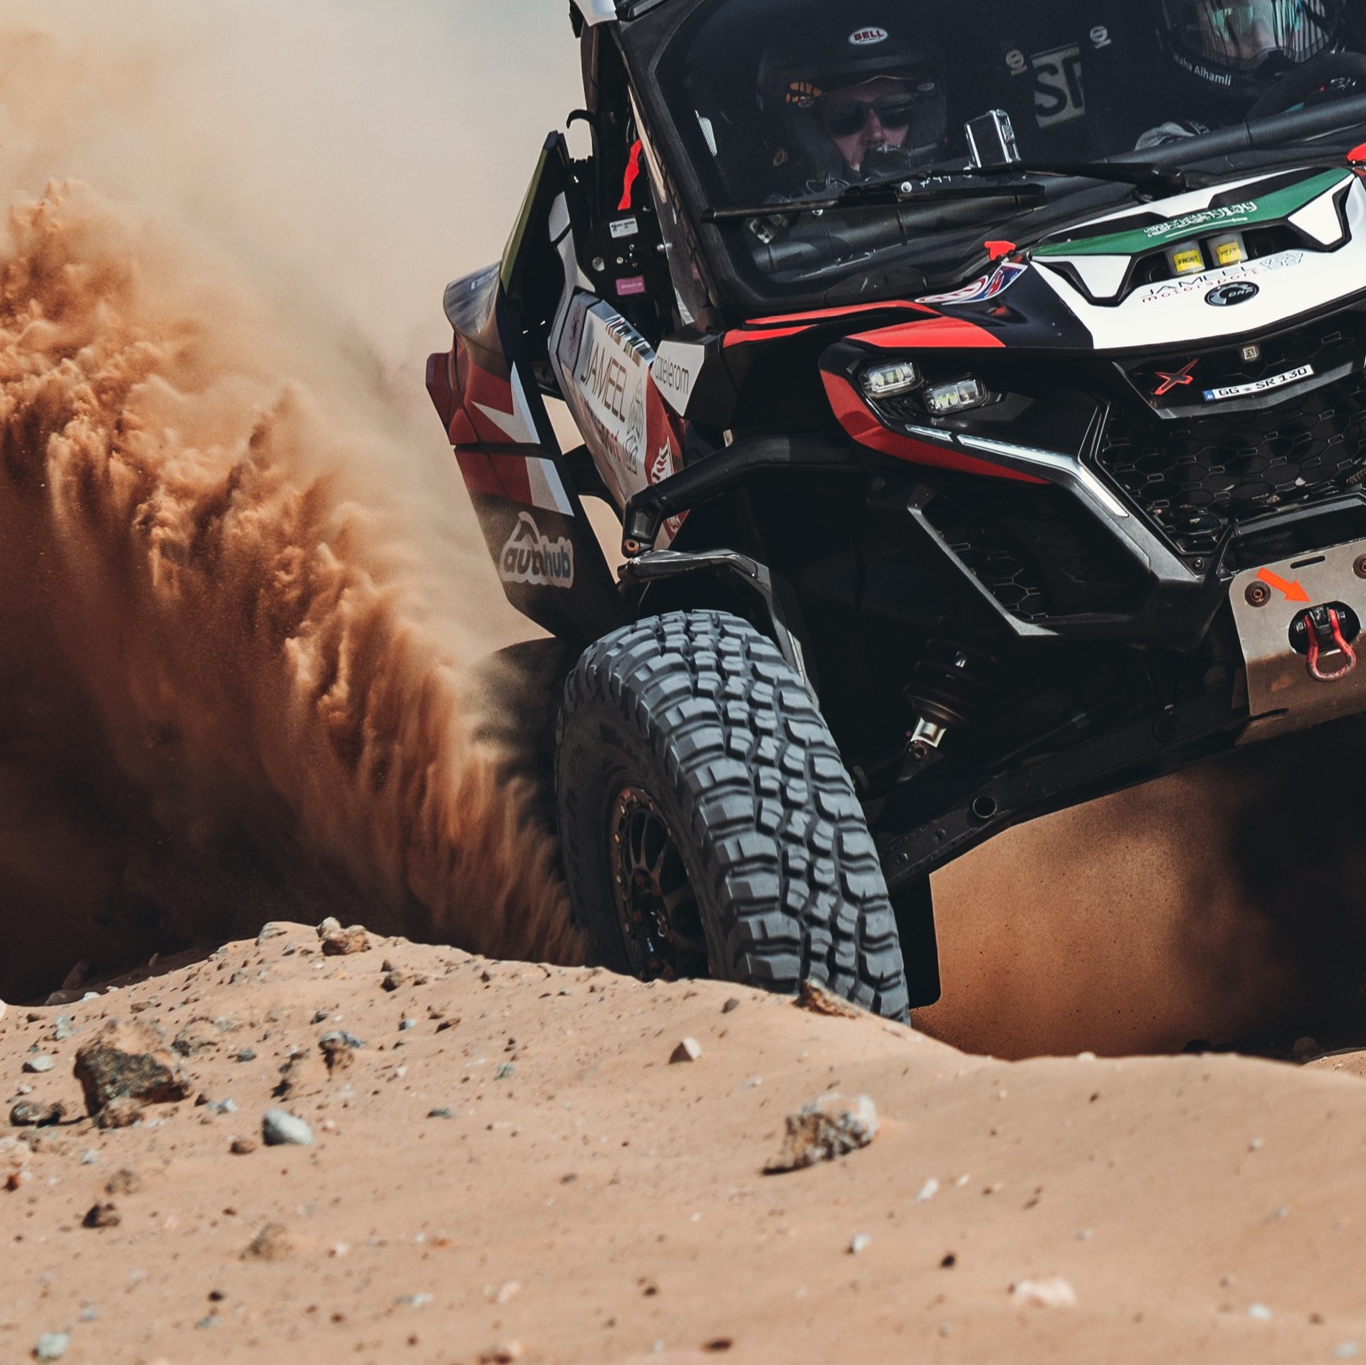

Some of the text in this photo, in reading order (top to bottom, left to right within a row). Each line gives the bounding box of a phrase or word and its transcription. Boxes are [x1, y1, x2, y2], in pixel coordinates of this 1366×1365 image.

[853, 29, 884, 41] BELL
[1194, 65, 1232, 86] Alhamli
[1178, 254, 1198, 266] FRONT
[1141, 265, 1256, 298] JAMEEL
[580, 338, 627, 423] JAMEEL
[1218, 367, 1308, 397] GG SR 130
